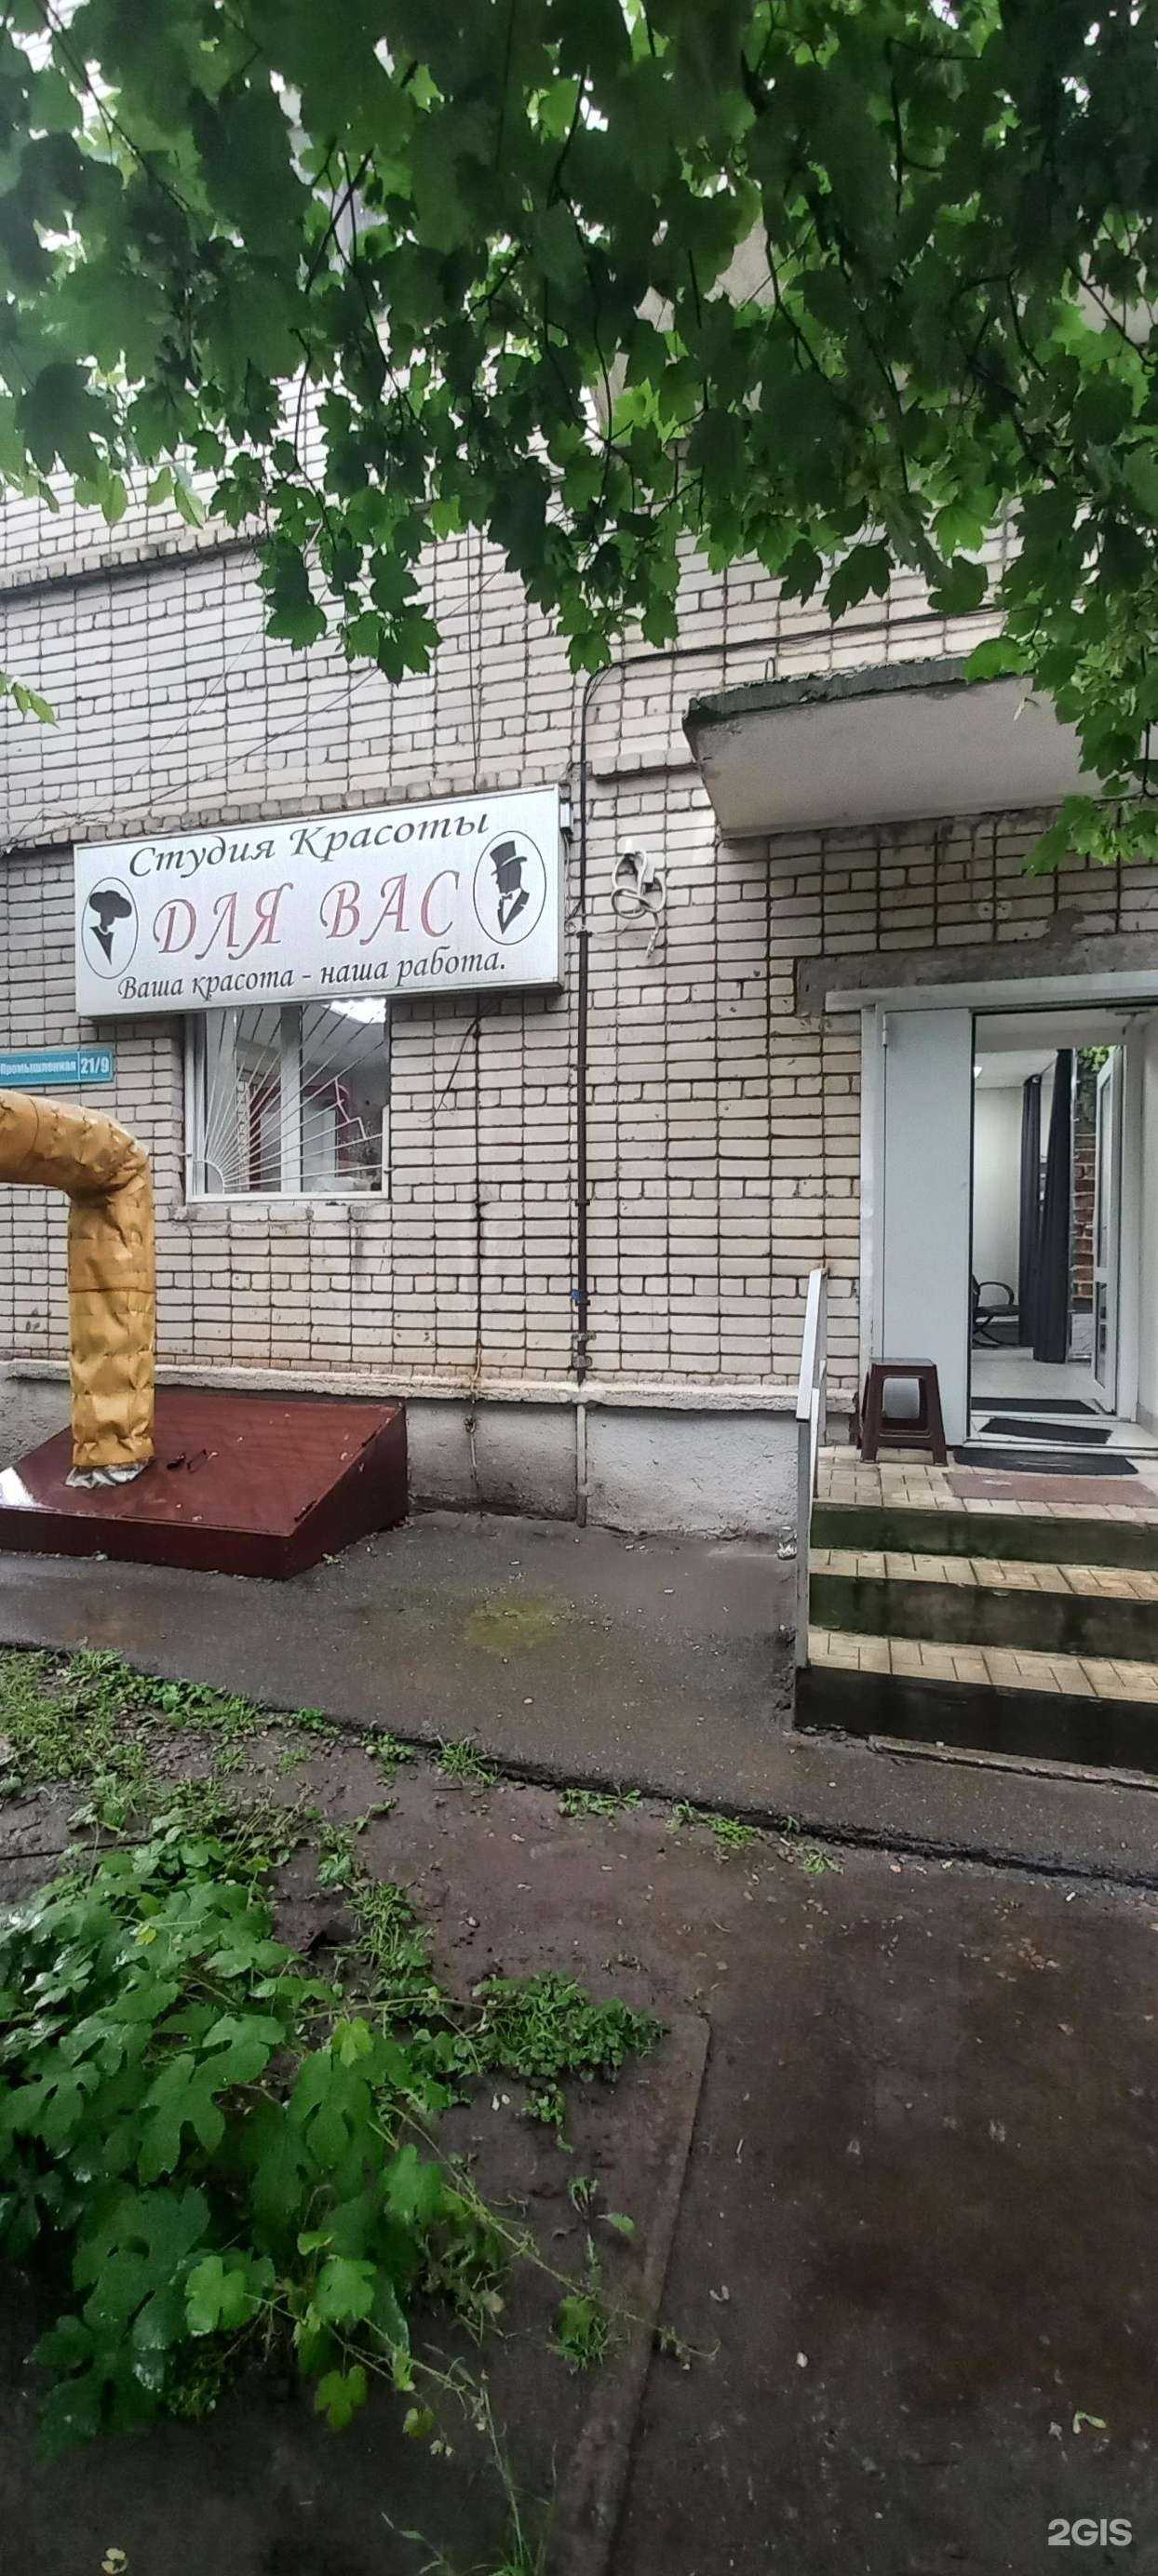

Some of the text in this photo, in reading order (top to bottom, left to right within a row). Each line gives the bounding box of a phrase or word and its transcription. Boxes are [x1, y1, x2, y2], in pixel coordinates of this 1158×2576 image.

[129, 812, 490, 879] Студия Красоты
[154, 869, 461, 961] ДЛЯ ВАС
[117, 975, 183, 1000] Ваша
[191, 970, 294, 1001] красота
[320, 961, 389, 986] наша
[396, 946, 505, 987] работа.
[80, 1055, 110, 1075] 21/9
